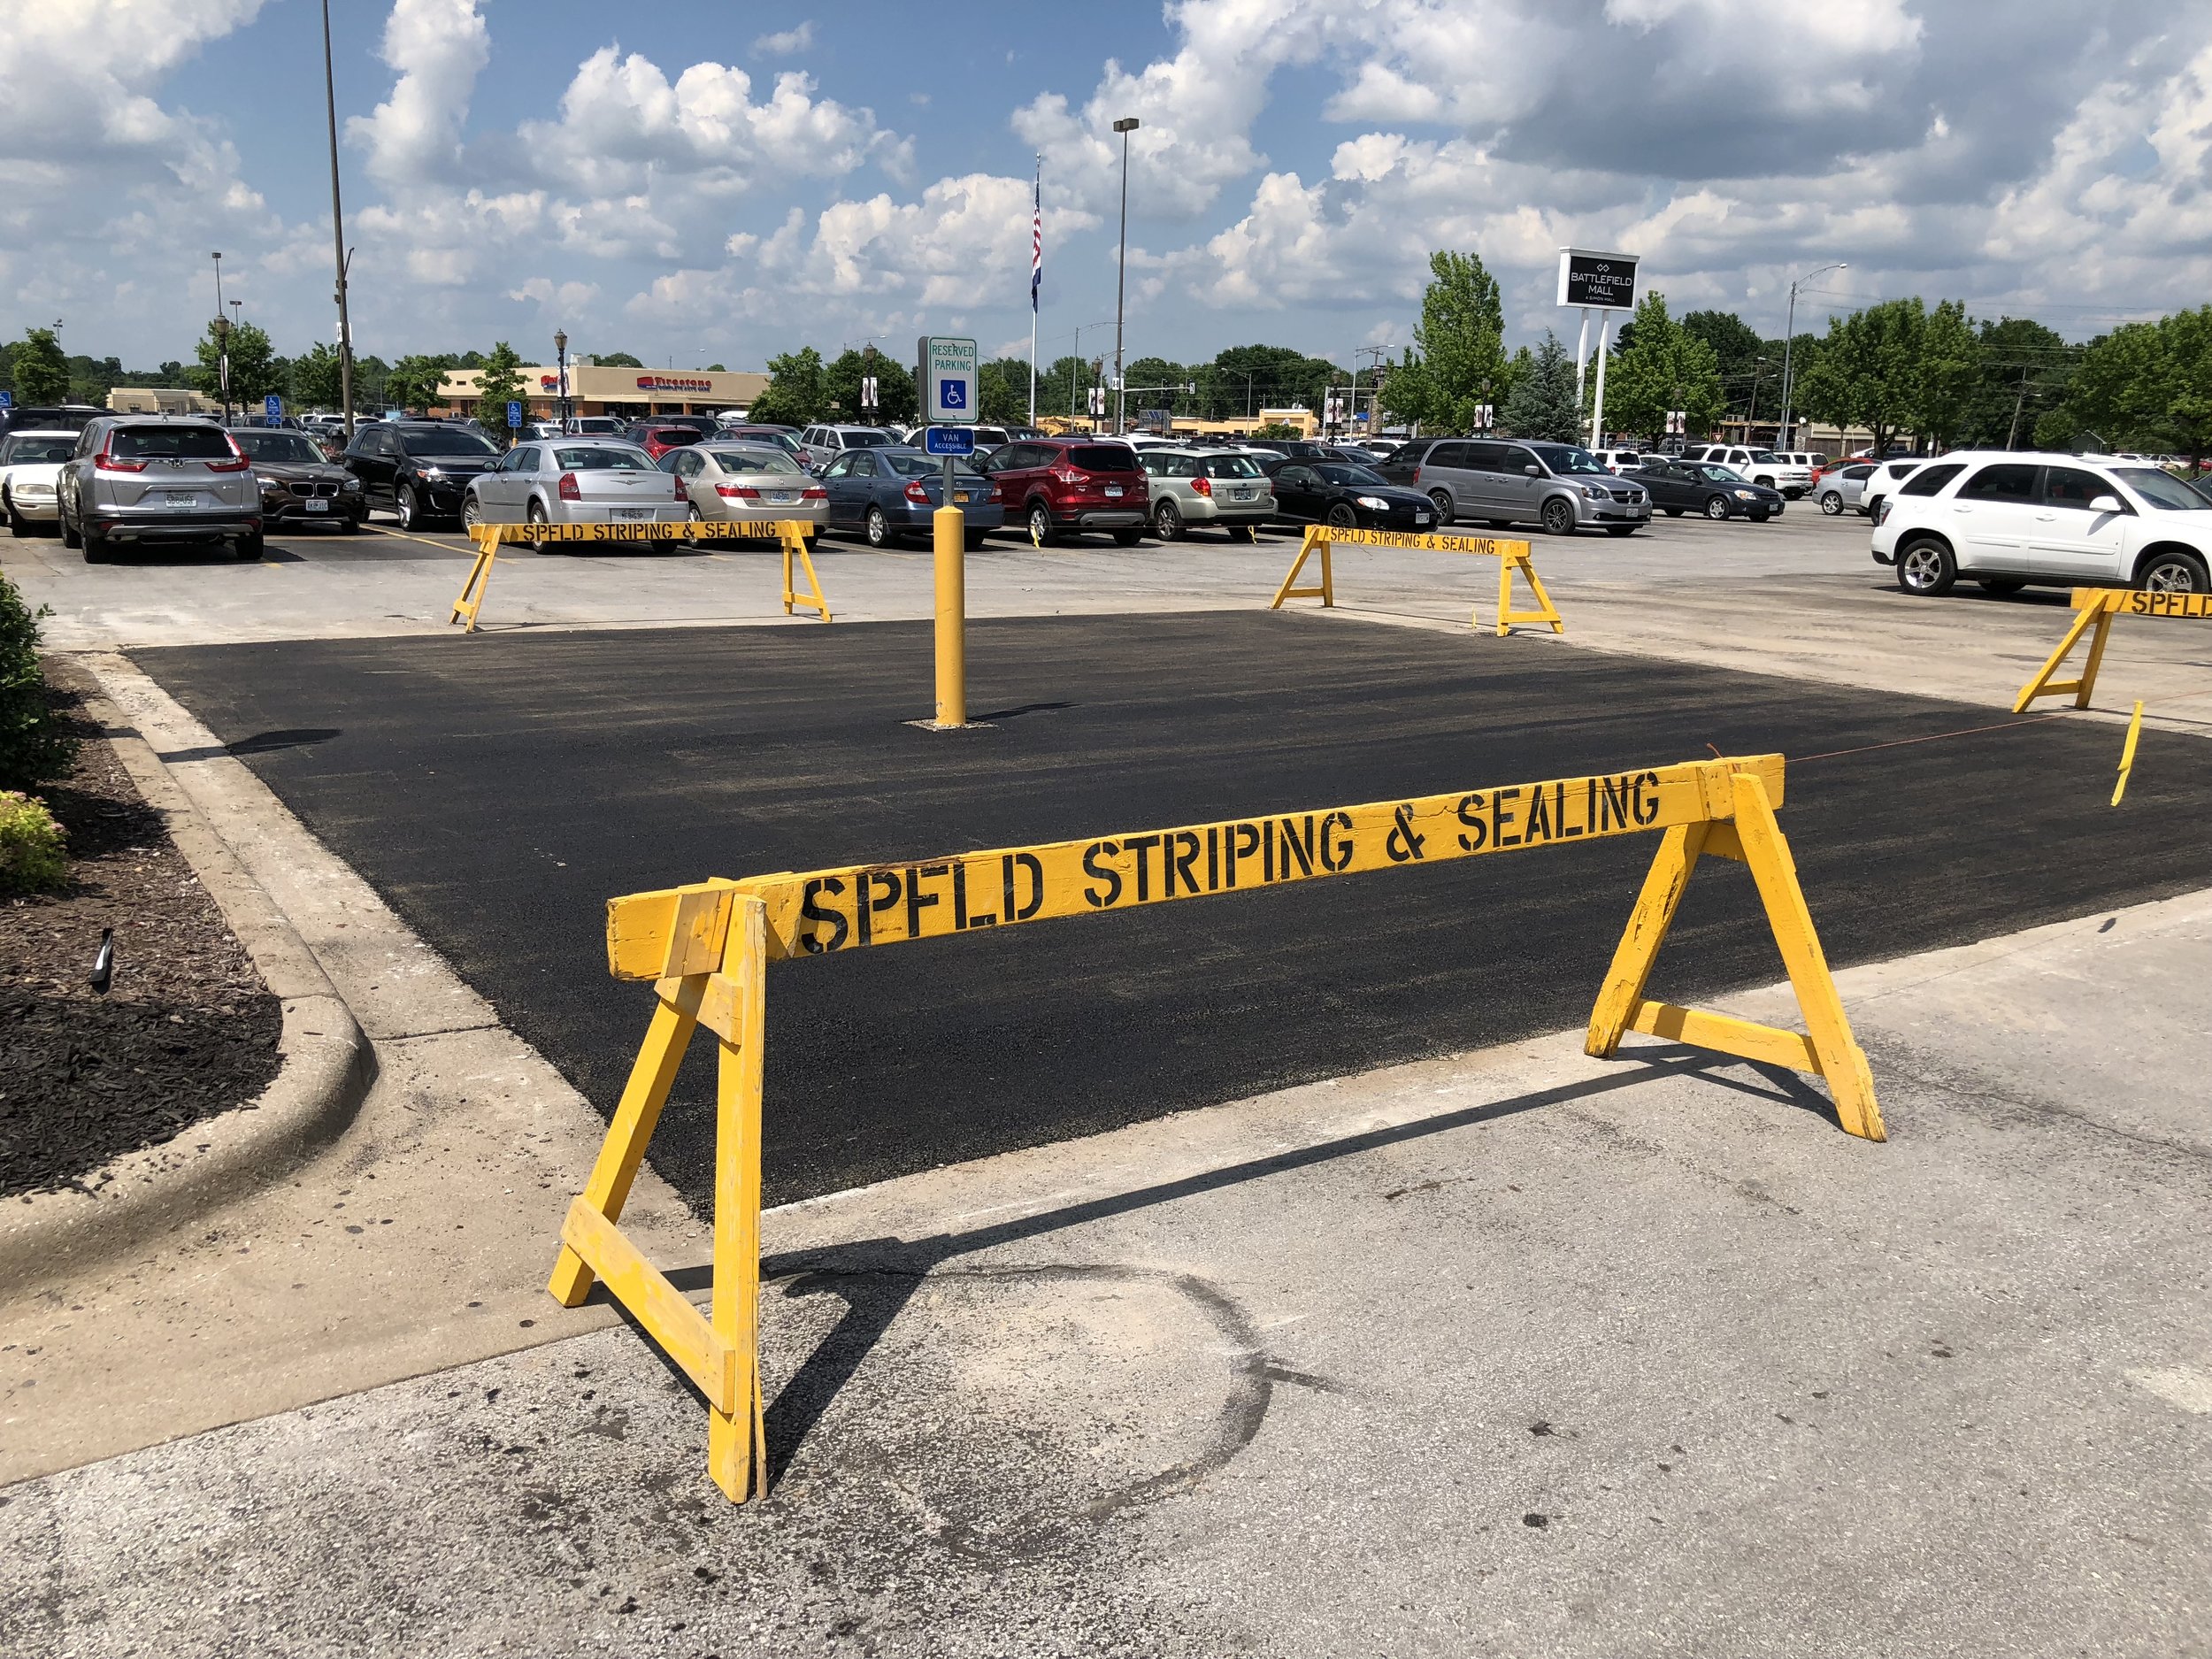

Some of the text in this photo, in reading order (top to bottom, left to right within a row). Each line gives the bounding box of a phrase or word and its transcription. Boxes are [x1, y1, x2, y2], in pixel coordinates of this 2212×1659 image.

[1571, 273, 1632, 287] BATTLEFIELD
[1588, 285, 1613, 296] MALL
[932, 344, 974, 357] RESERVED
[934, 359, 972, 372] PARKING
[654, 376, 712, 387] Firestone
[523, 522, 776, 541] SPFLD STRIPING & SEALING
[1331, 527, 1495, 554] SPFLD STRIPING & SEALING
[801, 771, 1659, 954] SPFLD STRIPING & SEALING
